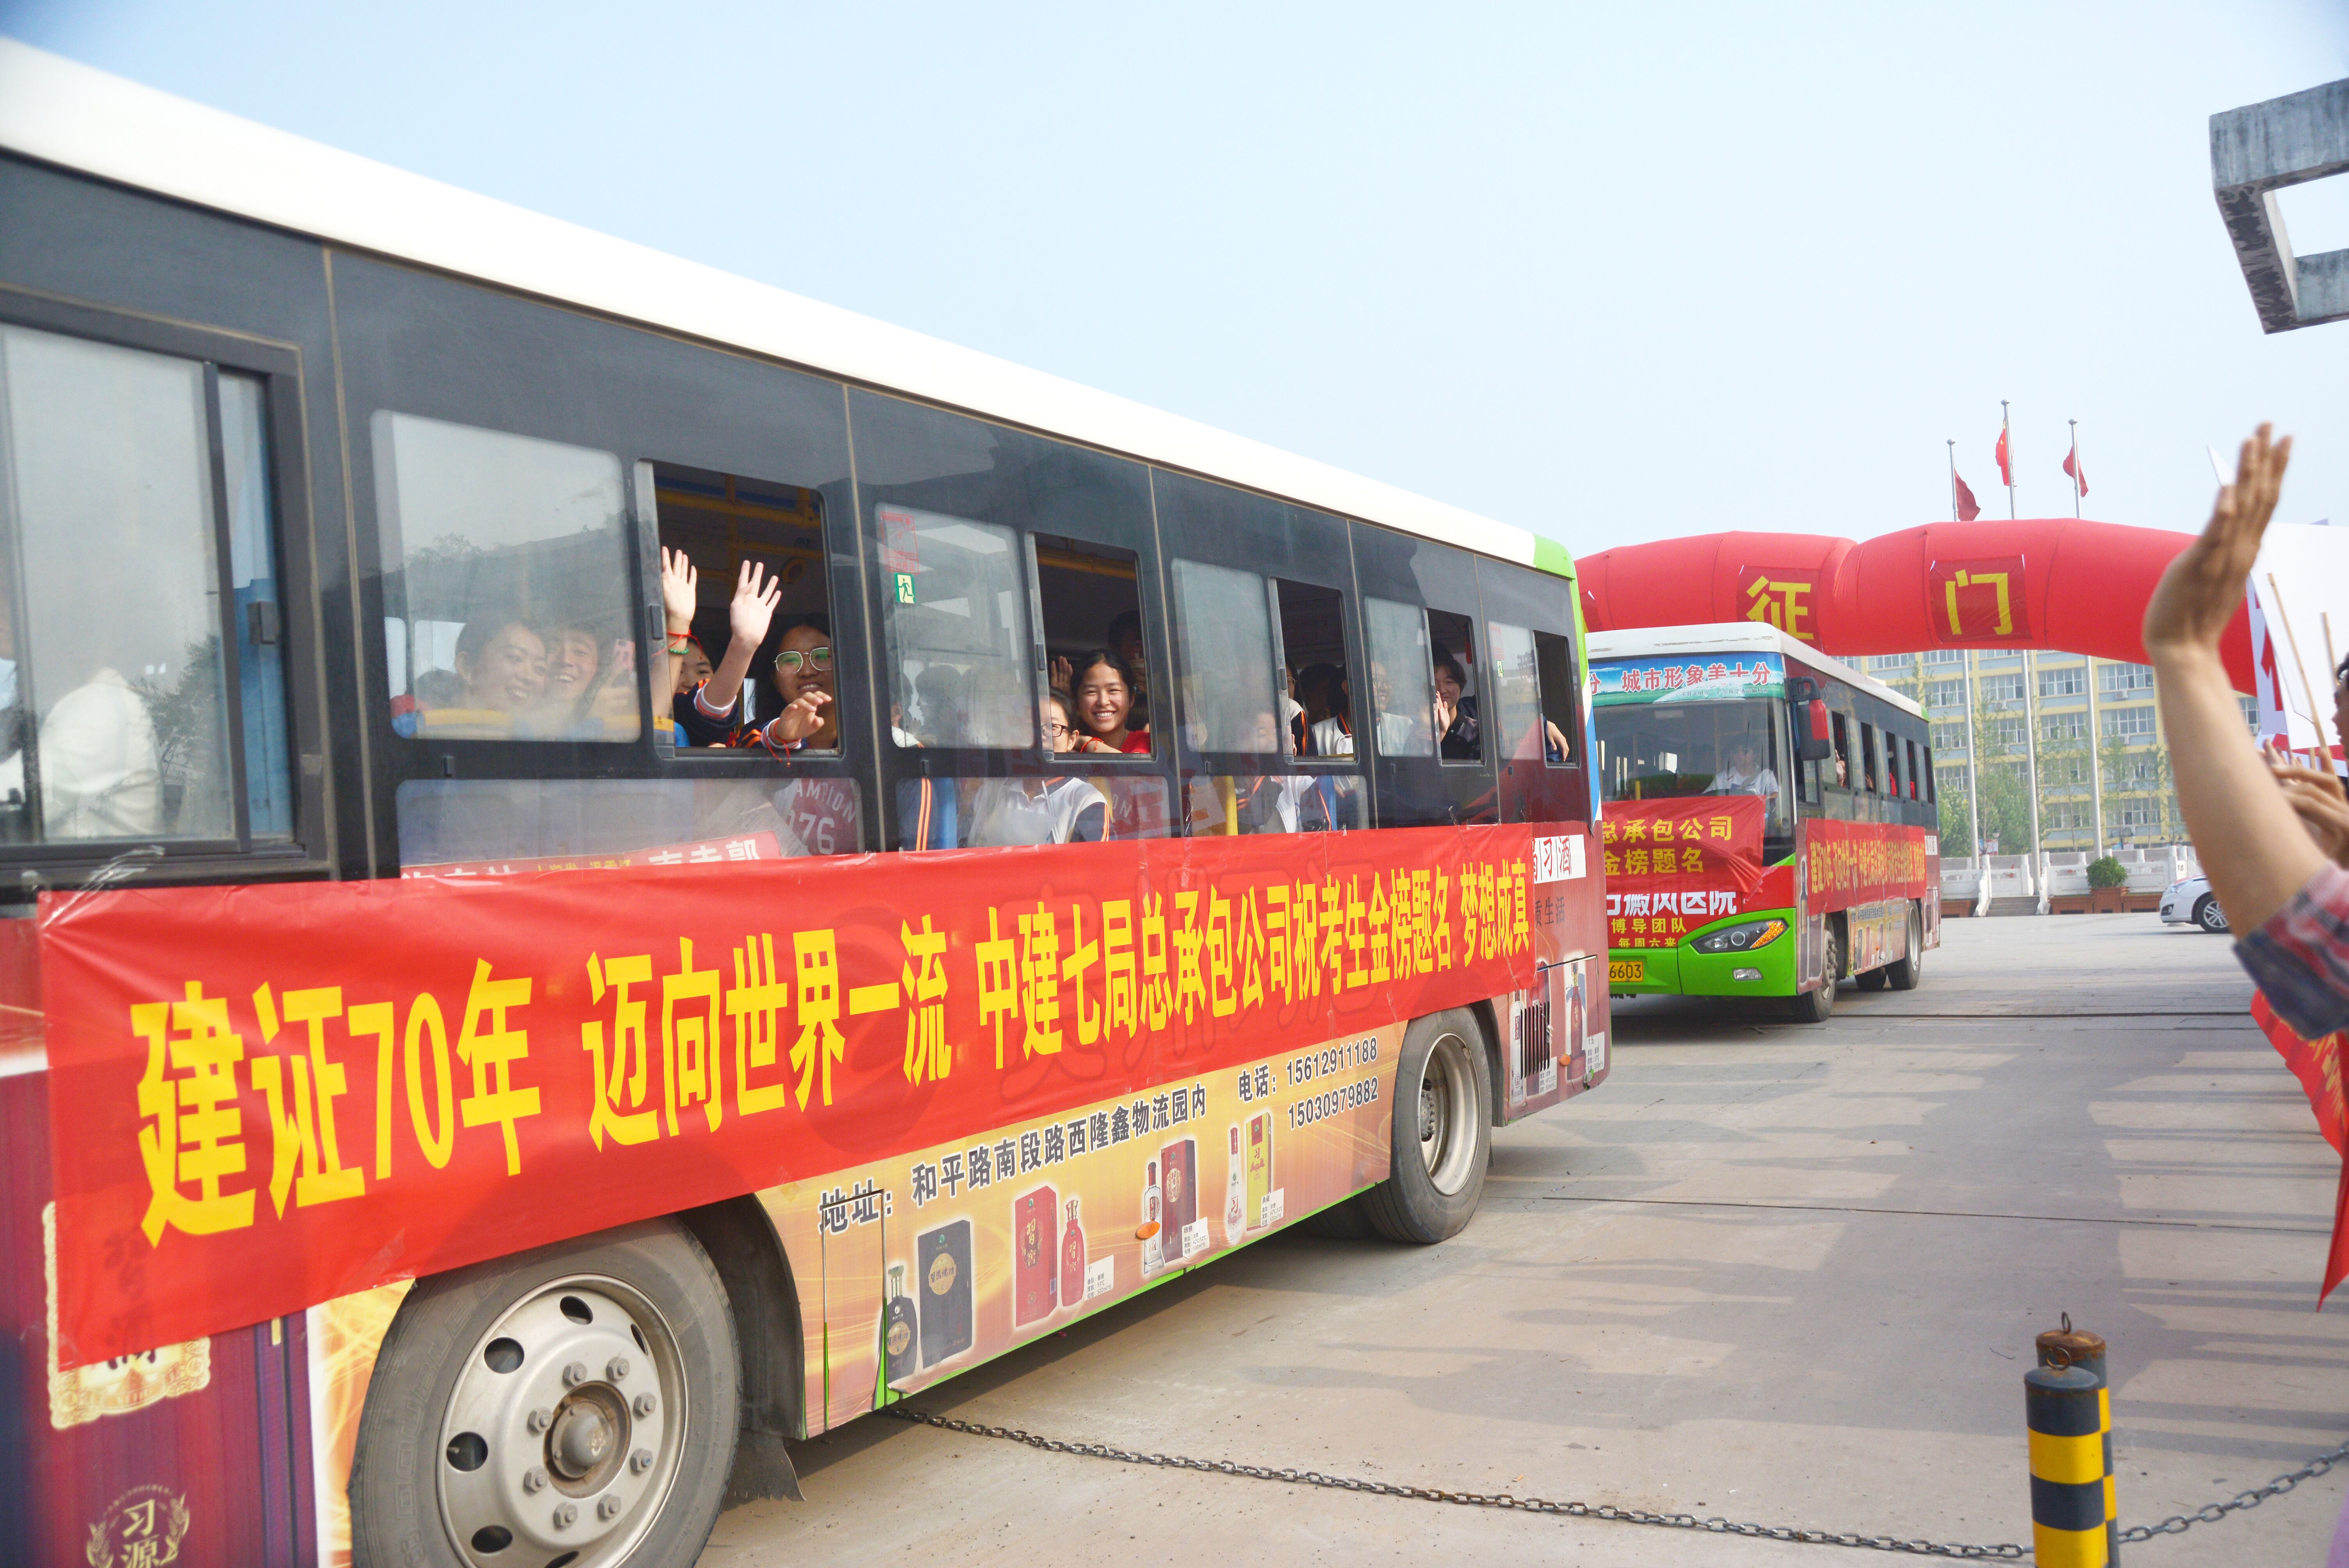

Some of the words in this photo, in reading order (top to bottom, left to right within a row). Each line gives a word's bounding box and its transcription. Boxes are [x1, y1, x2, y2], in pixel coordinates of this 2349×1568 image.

[1747, 576, 1813, 640] 征
[1946, 570, 2012, 635] 门
[1602, 816, 1732, 844] 总承包公司
[1603, 847, 1704, 876] 金榜题名
[1611, 918, 1686, 934] 博导团队
[1609, 965, 1642, 978] 6603
[131, 957, 541, 1249] 建证70年
[582, 914, 952, 1152] 迈向世界一流
[975, 865, 1453, 1069] 中建七局总承包公司祝考生金榜题名
[1460, 857, 1529, 968] 梦想成真
[1239, 1065, 1276, 1101] 电话：
[1287, 1038, 1377, 1085] 15612911188
[1289, 1078, 1378, 1129] 15030979882
[912, 1083, 1205, 1206] 和平路南段路西隆鑫物流园内
